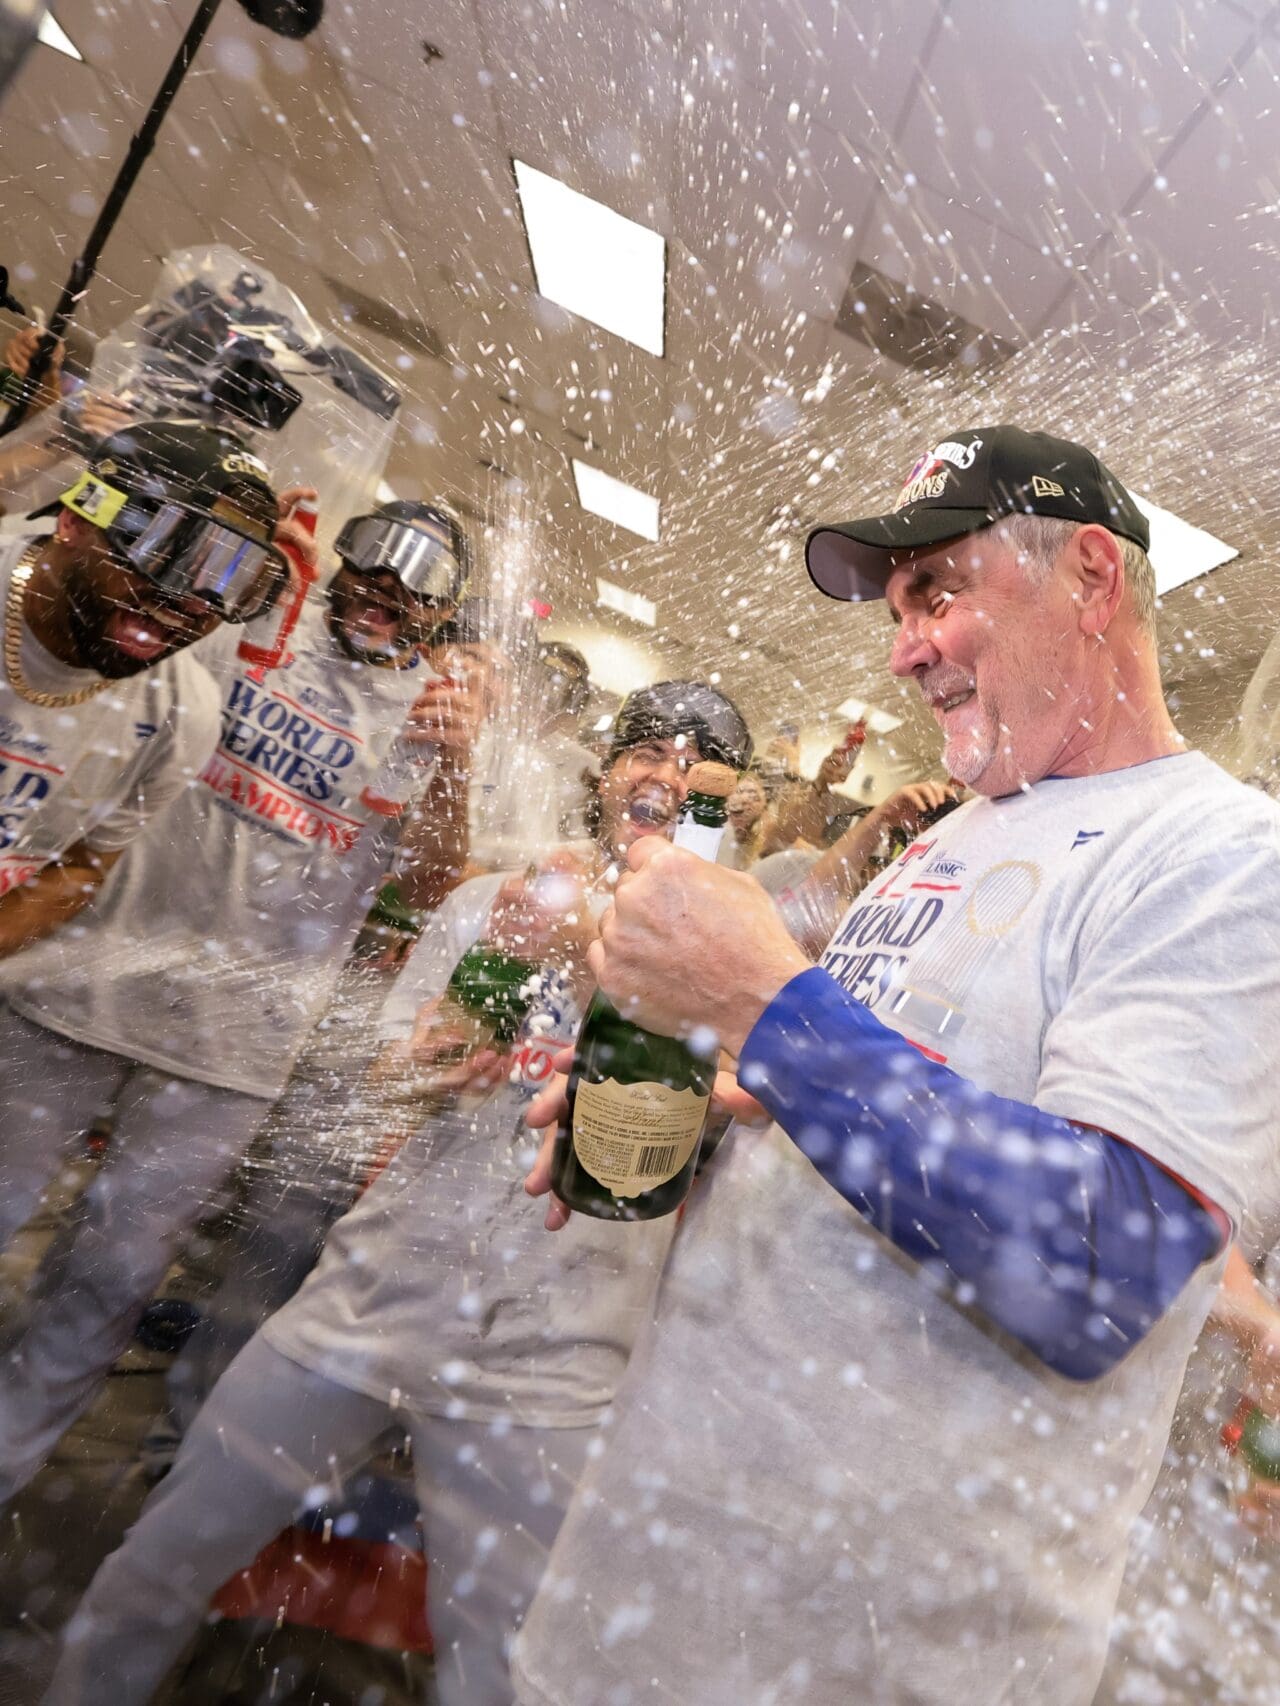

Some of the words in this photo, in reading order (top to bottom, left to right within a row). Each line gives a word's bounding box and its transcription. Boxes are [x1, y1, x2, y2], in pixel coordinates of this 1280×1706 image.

[227, 679, 355, 770] WORLD
[198, 755, 361, 855] HAMPIONS
[834, 897, 944, 949] WORLD
[823, 951, 909, 1009] ERIES
